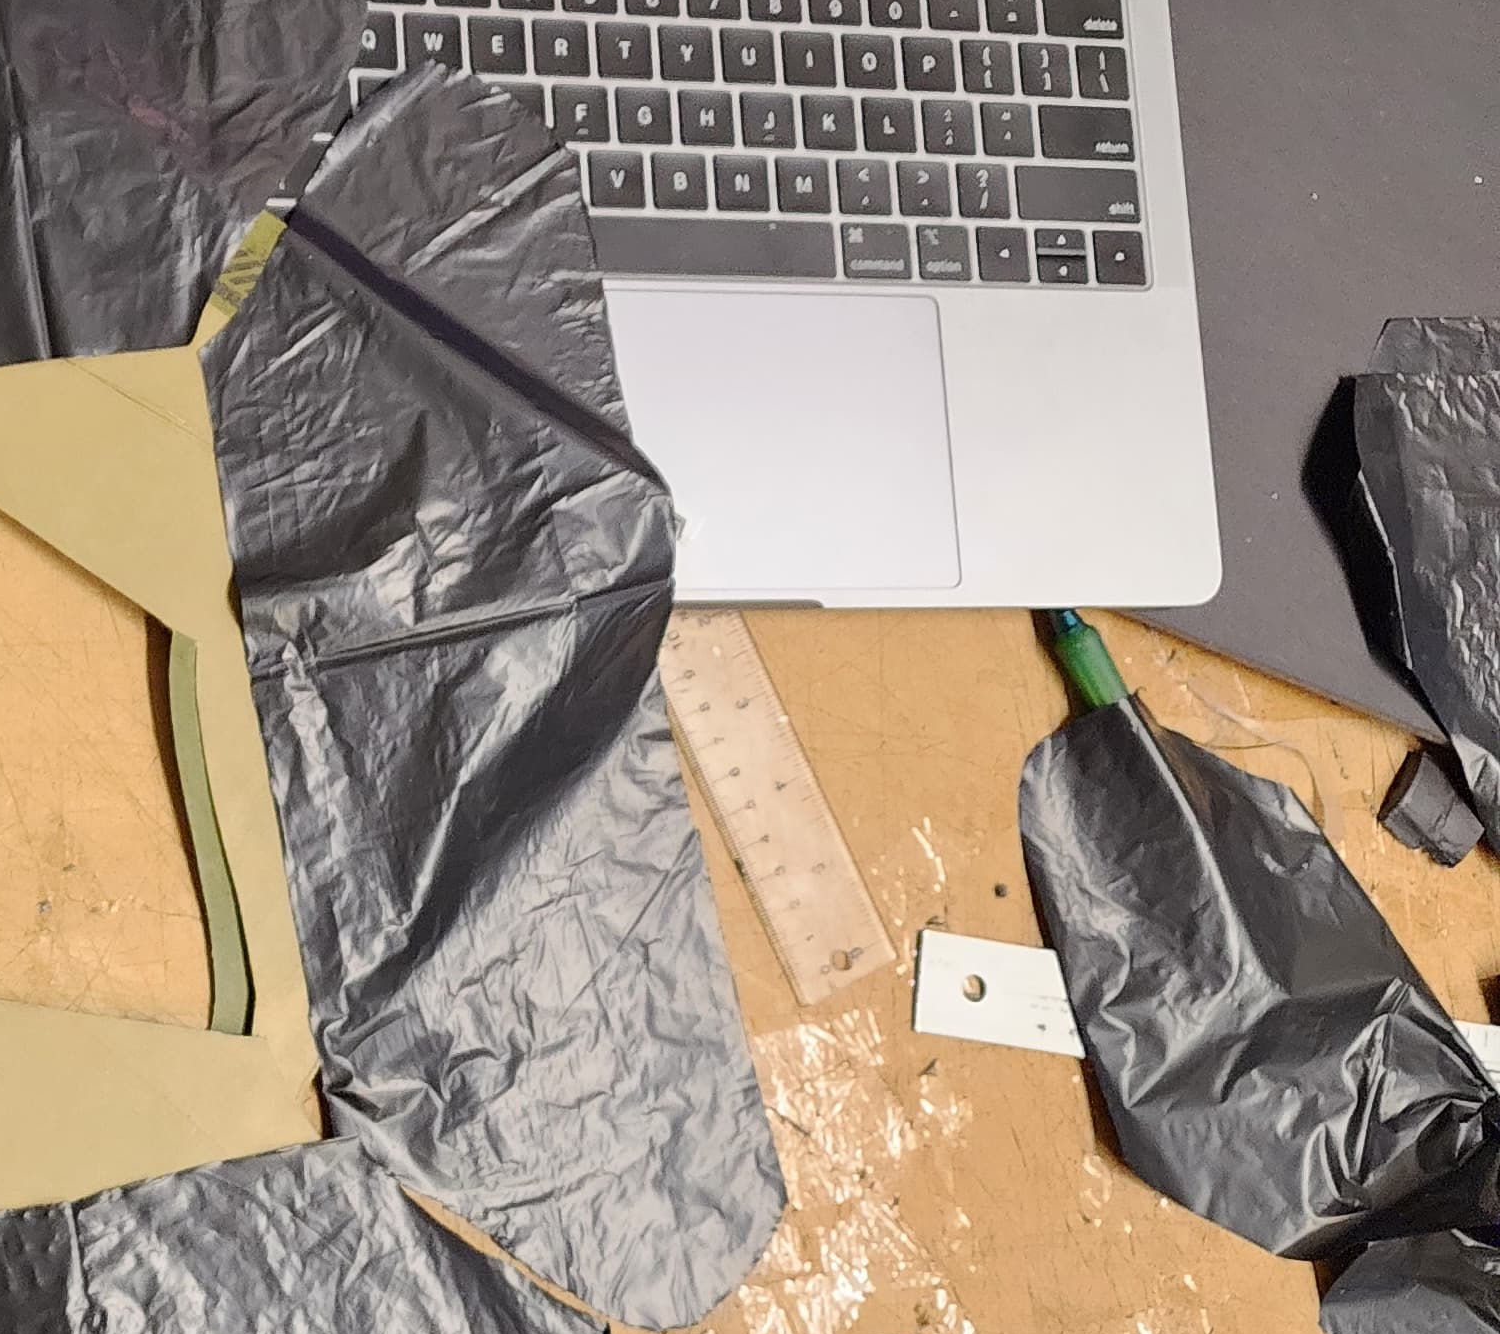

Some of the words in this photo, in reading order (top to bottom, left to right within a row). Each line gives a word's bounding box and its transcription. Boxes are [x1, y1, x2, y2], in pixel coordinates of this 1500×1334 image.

[361, 29, 377, 51] Q
[422, 31, 444, 52] W
[491, 34, 504, 55] E
[553, 37, 569, 57] R
[617, 40, 632, 60] T
[679, 43, 694, 63] Y
[741, 45, 757, 67] U
[861, 50, 878, 72] O
[921, 53, 936, 74] P
